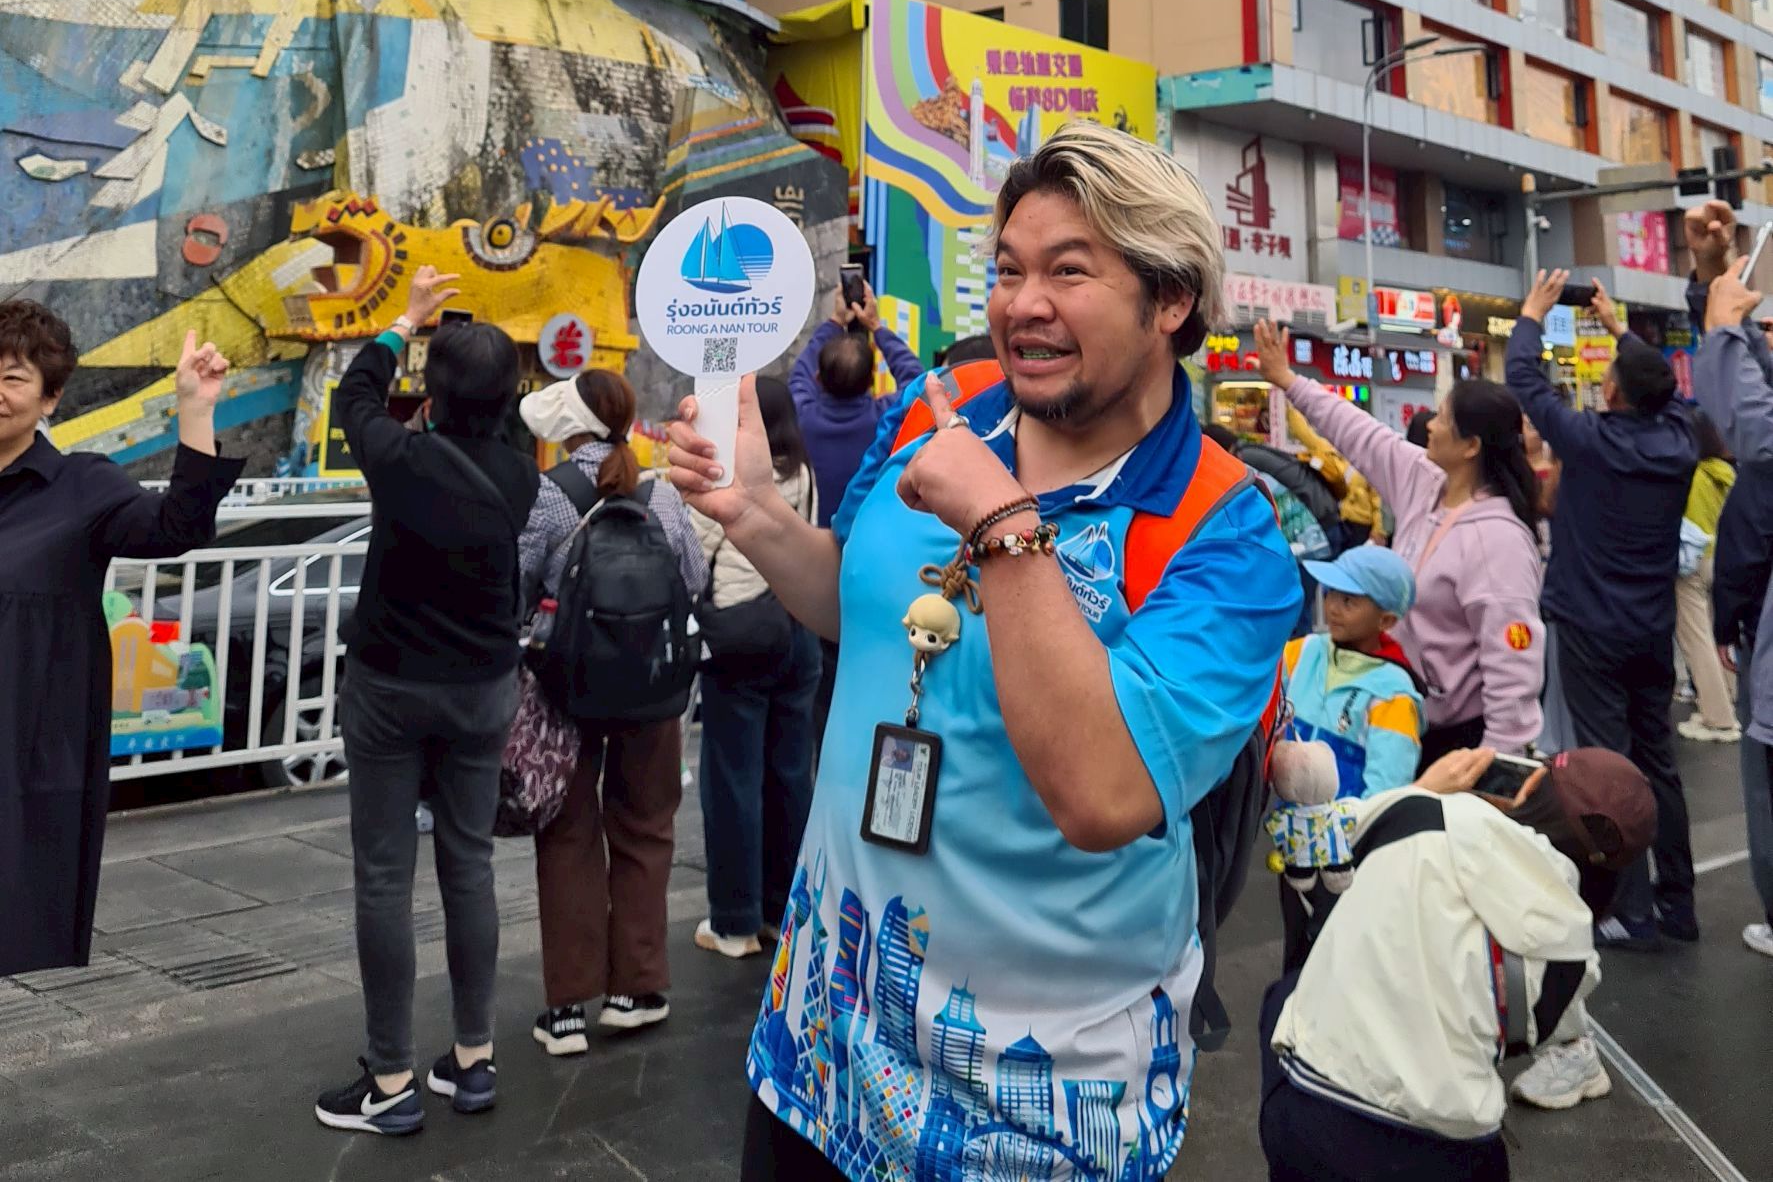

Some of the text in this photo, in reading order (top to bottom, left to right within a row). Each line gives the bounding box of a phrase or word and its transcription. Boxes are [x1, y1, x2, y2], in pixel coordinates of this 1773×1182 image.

[665, 295, 784, 323] รุ่งอนันต์ทัวร์
[749, 322, 778, 333] TOUR
